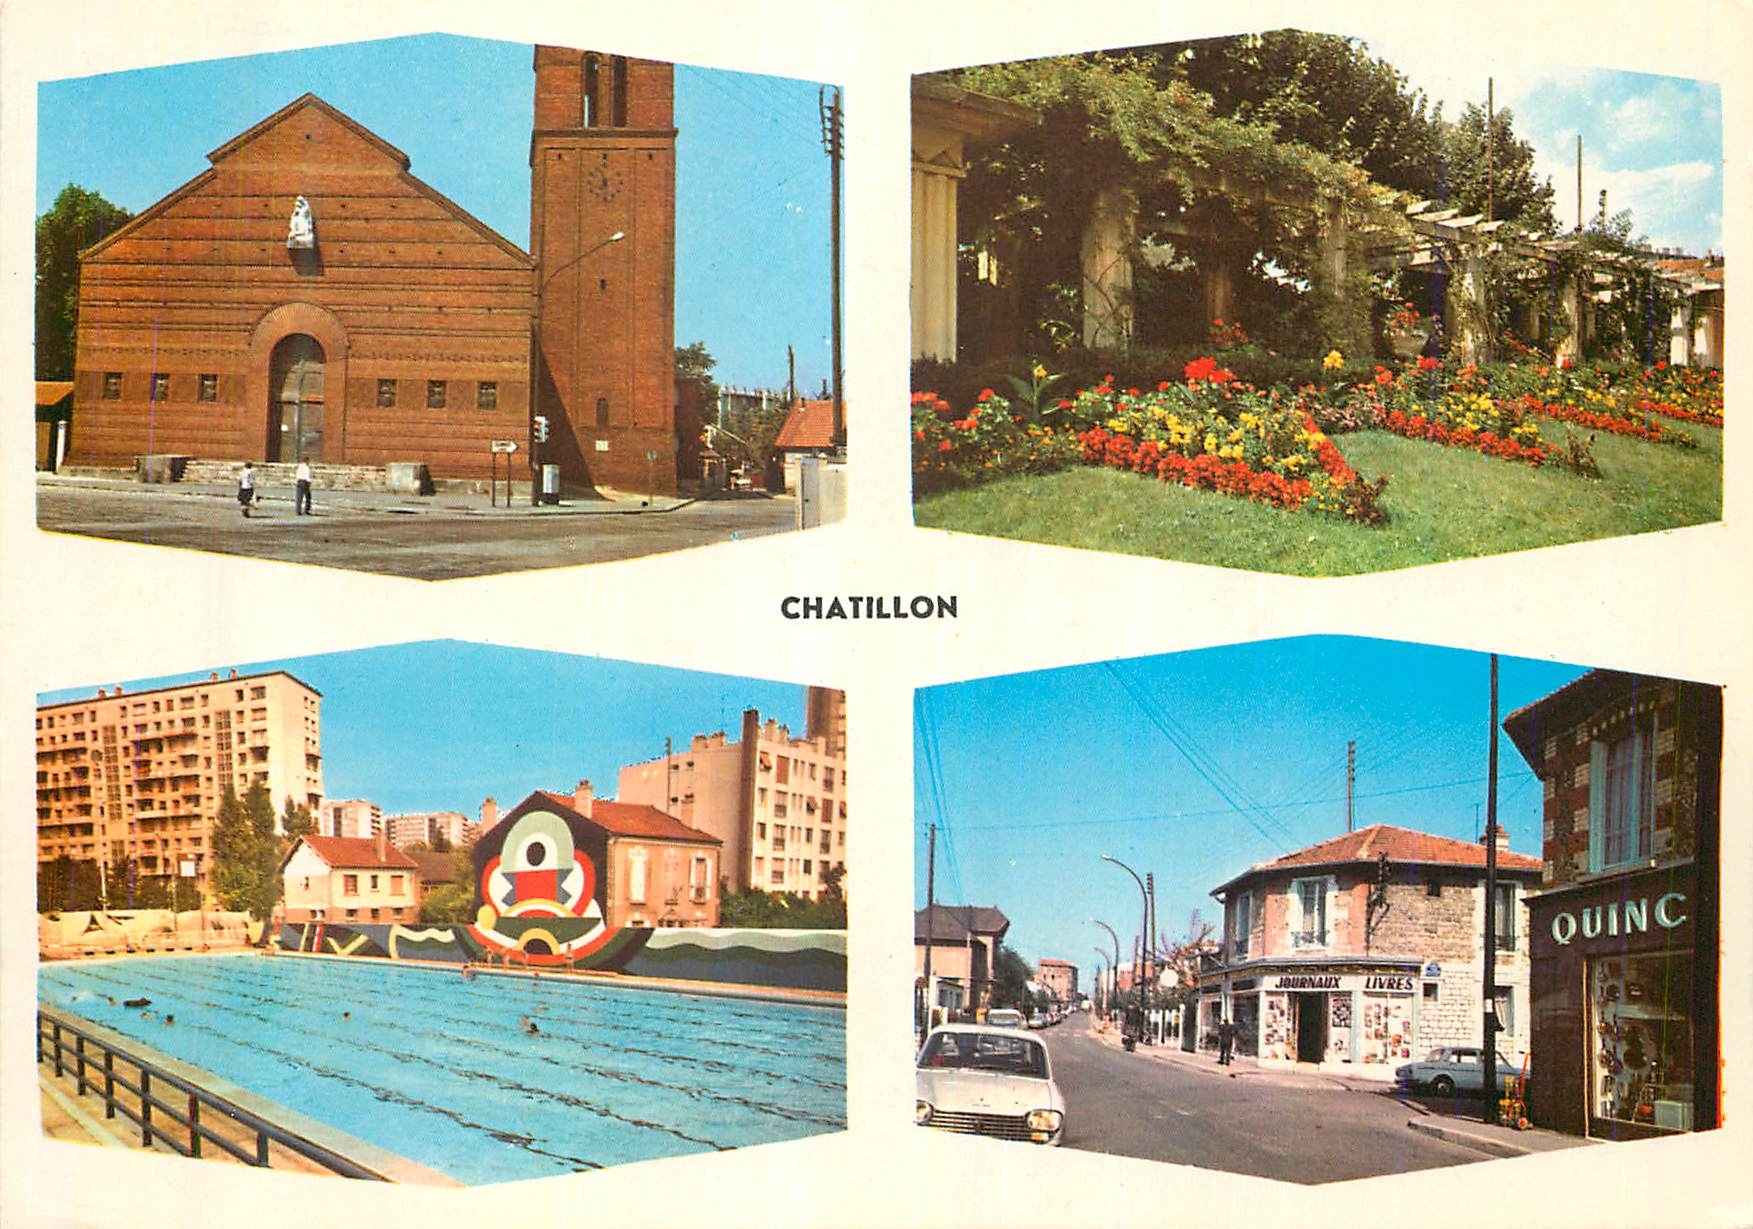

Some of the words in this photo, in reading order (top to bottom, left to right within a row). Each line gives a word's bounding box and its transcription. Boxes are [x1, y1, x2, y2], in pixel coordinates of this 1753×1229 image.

[1552, 893, 1687, 945] QUINC
[1275, 976, 1341, 989] JOURNAUX
[1365, 977, 1413, 990] LIVRES
